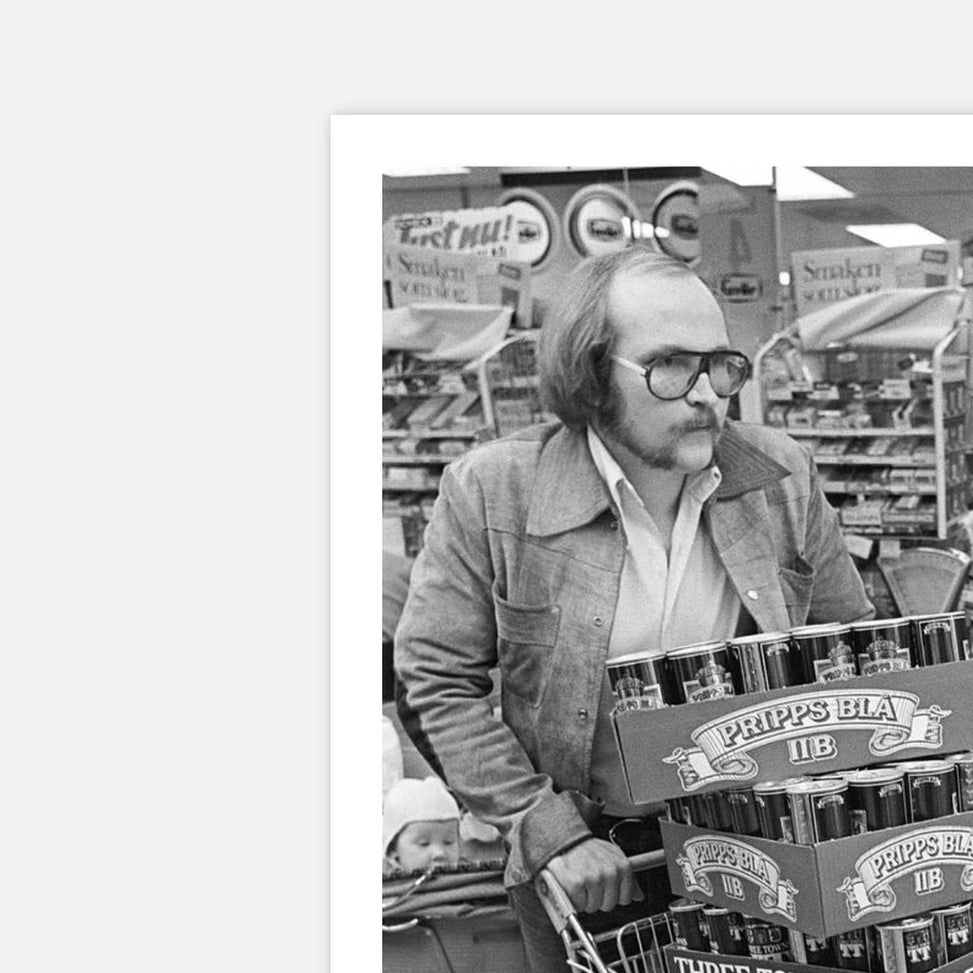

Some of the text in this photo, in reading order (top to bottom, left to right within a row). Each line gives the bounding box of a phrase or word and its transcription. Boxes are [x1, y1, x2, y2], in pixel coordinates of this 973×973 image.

[803, 258, 882, 282] Smaken
[716, 699, 831, 747] PRIPPS
[786, 734, 838, 763] IIB
[693, 842, 738, 867] PRIPPS
[868, 834, 940, 880] PRIPPS
[721, 873, 745, 901] IIB
[914, 867, 945, 896] IIB
